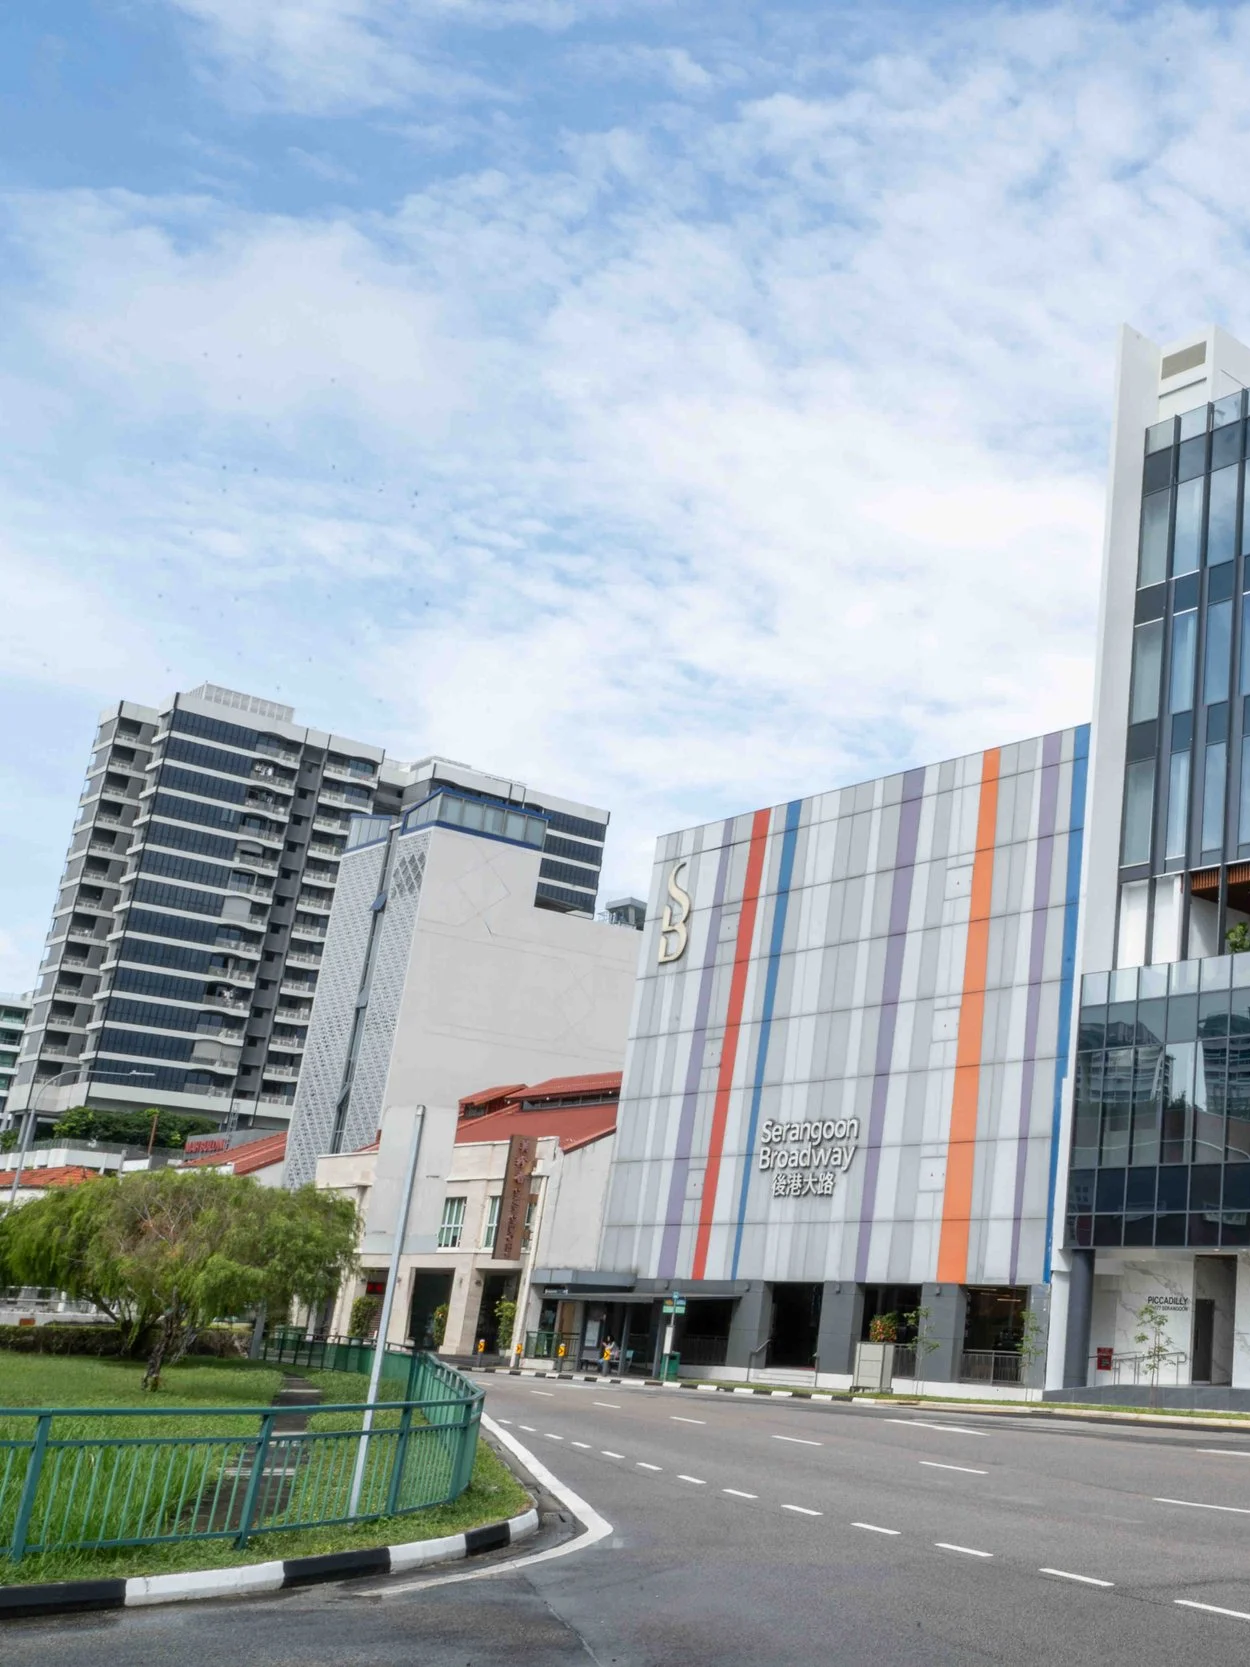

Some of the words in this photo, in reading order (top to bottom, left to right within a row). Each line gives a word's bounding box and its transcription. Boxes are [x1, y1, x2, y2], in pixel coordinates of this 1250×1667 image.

[760, 1118, 859, 1145] Serangoon
[758, 1143, 857, 1172] Broadway
[771, 1171, 836, 1198] 後港大路
[1147, 1295, 1189, 1305] PICCADILLY
